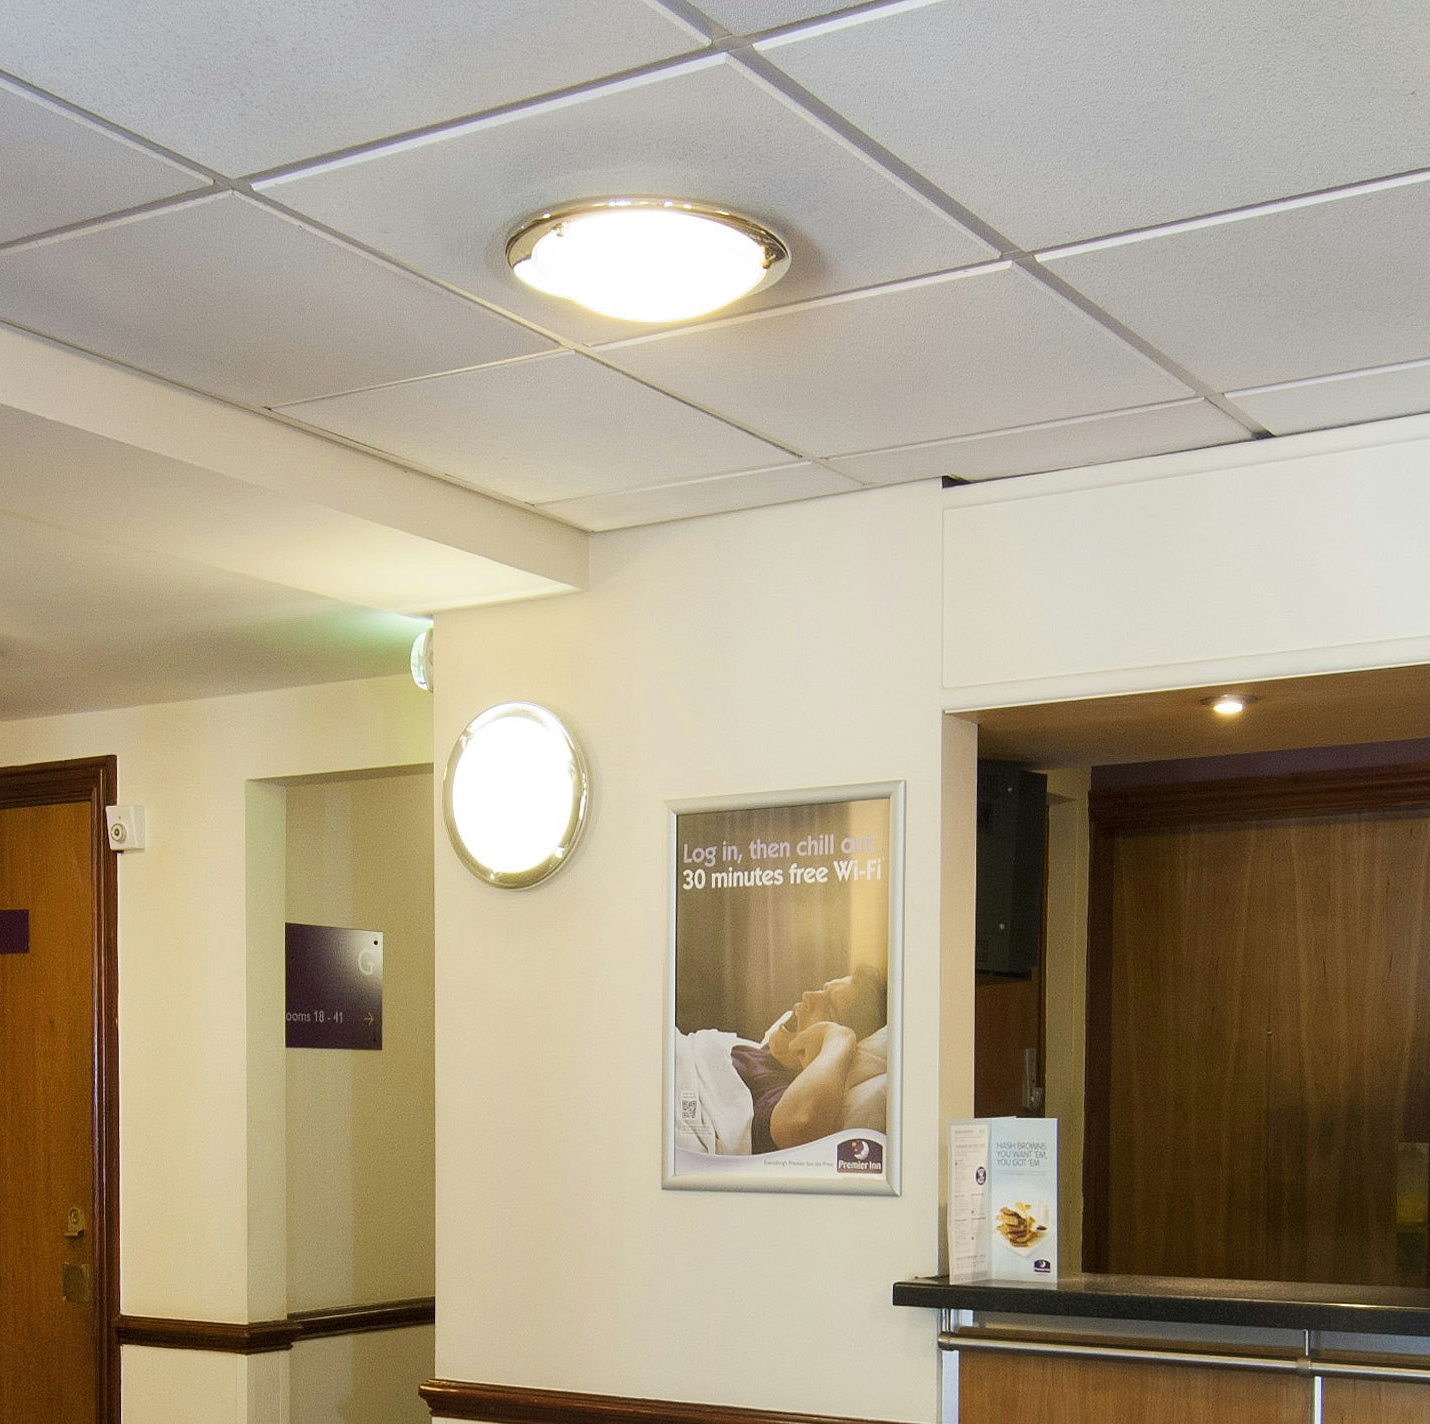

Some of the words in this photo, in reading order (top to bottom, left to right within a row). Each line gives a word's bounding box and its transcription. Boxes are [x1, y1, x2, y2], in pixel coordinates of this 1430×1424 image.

[683, 843, 717, 867] Log
[722, 840, 743, 864] in,
[750, 839, 791, 859] then
[796, 834, 835, 856] chill
[682, 868, 706, 890] 30
[711, 867, 784, 889] minutes
[789, 863, 829, 885] free
[358, 949, 374, 975] G
[286, 1012, 311, 1022] ooms
[314, 1010, 325, 1023] 18
[838, 1160, 868, 1170] Premier
[869, 1160, 882, 1170] Inn
